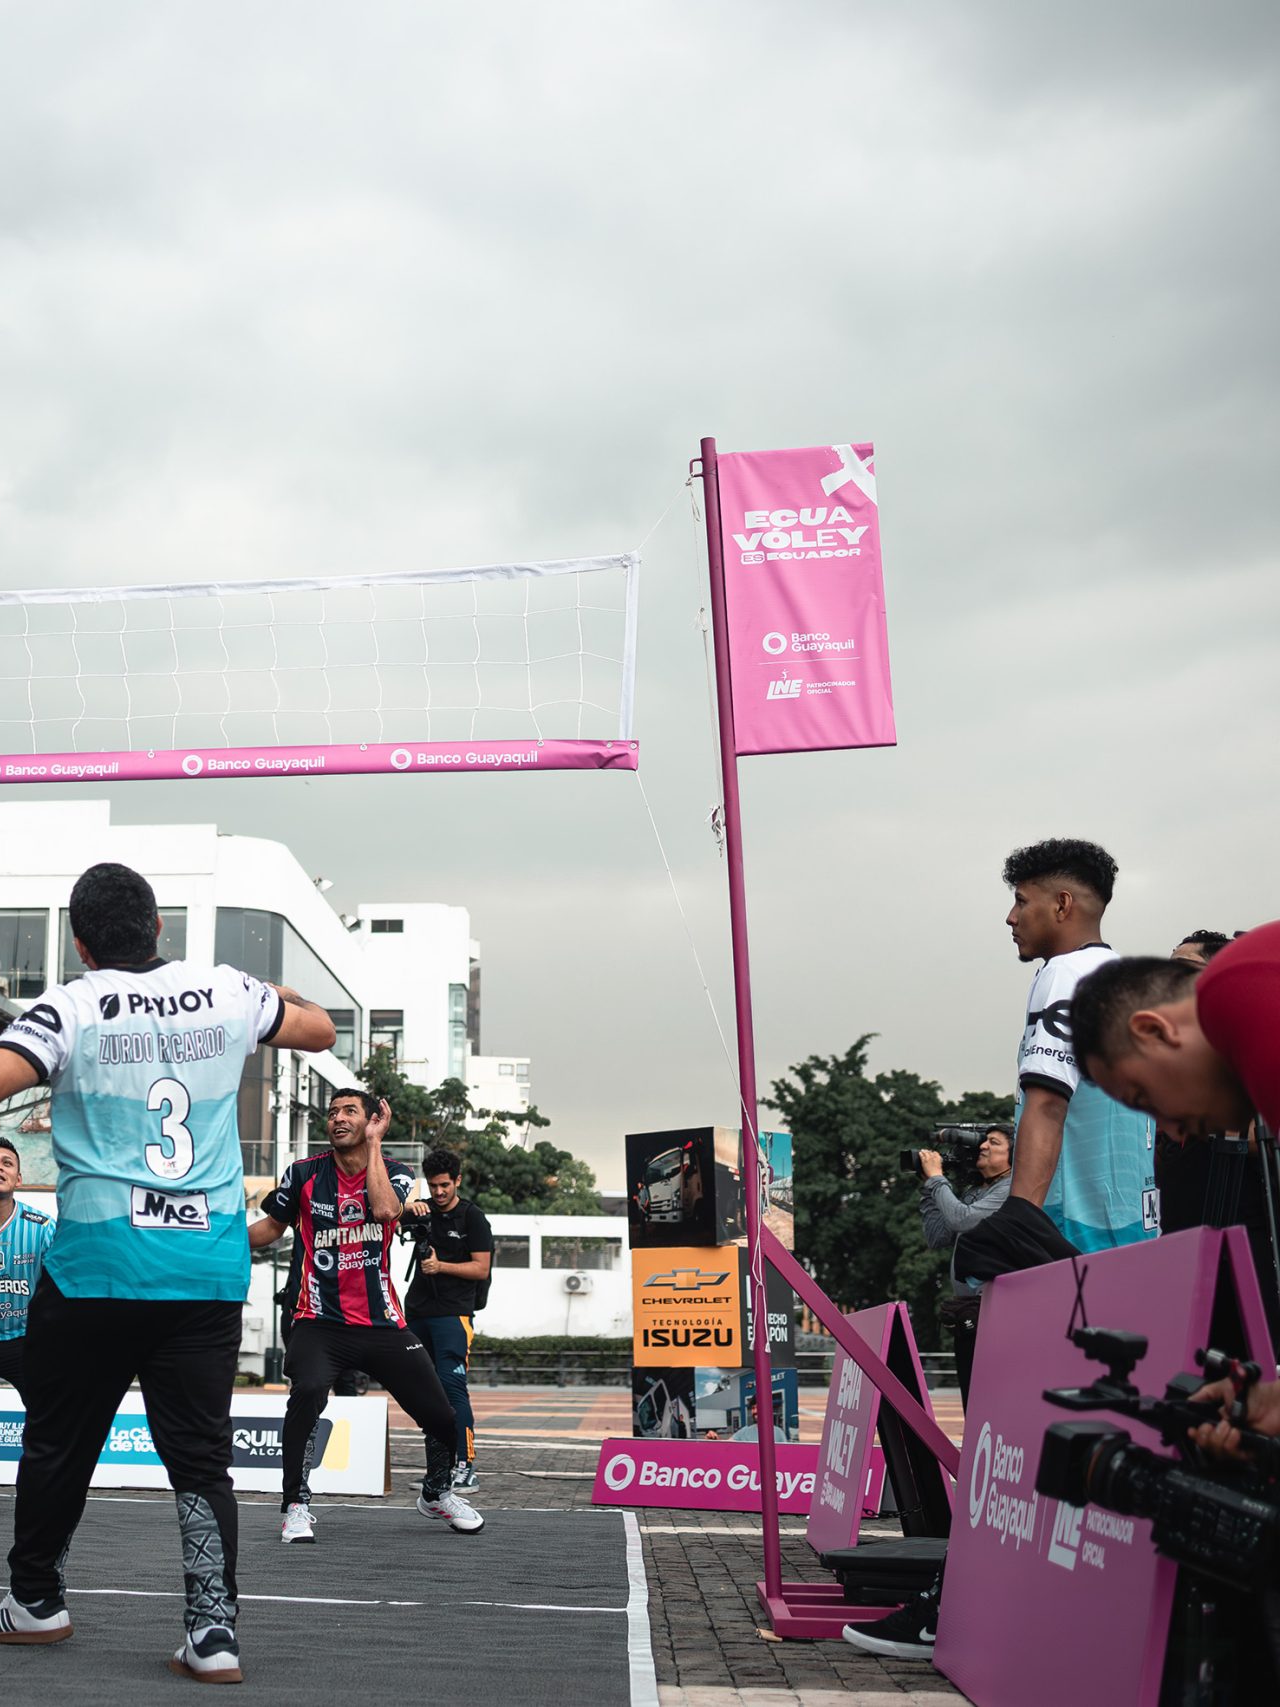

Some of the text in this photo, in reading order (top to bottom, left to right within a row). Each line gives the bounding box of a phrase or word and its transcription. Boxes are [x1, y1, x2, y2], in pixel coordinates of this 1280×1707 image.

[744, 505, 855, 529] ECUA
[731, 525, 869, 551] VÓLEY
[766, 548, 862, 561] ECUADOR
[791, 632, 830, 643] Banco
[791, 639, 855, 652] Guayaquil
[208, 756, 325, 771] Banco Guayaquil
[417, 750, 538, 766] Banco Guayaquil
[5, 762, 119, 778] Banco Guayaquil
[99, 1025, 225, 1065] ZURDO RCARDO
[145, 1077, 194, 1180] 3
[314, 1223, 383, 1249] CAPITALNOS
[642, 1296, 732, 1305] CHEVROLET
[653, 1317, 723, 1326] TECNOLOGÍA
[643, 1328, 733, 1347] ISUZU
[110, 1427, 129, 1440] La
[233, 1429, 282, 1449] QUIL
[109, 1440, 132, 1452] de
[250, 1448, 282, 1456] ALCA
[992, 1434, 1024, 1484] Banco
[639, 1461, 721, 1489] Banco
[986, 1482, 1039, 1550] Guayaquil
